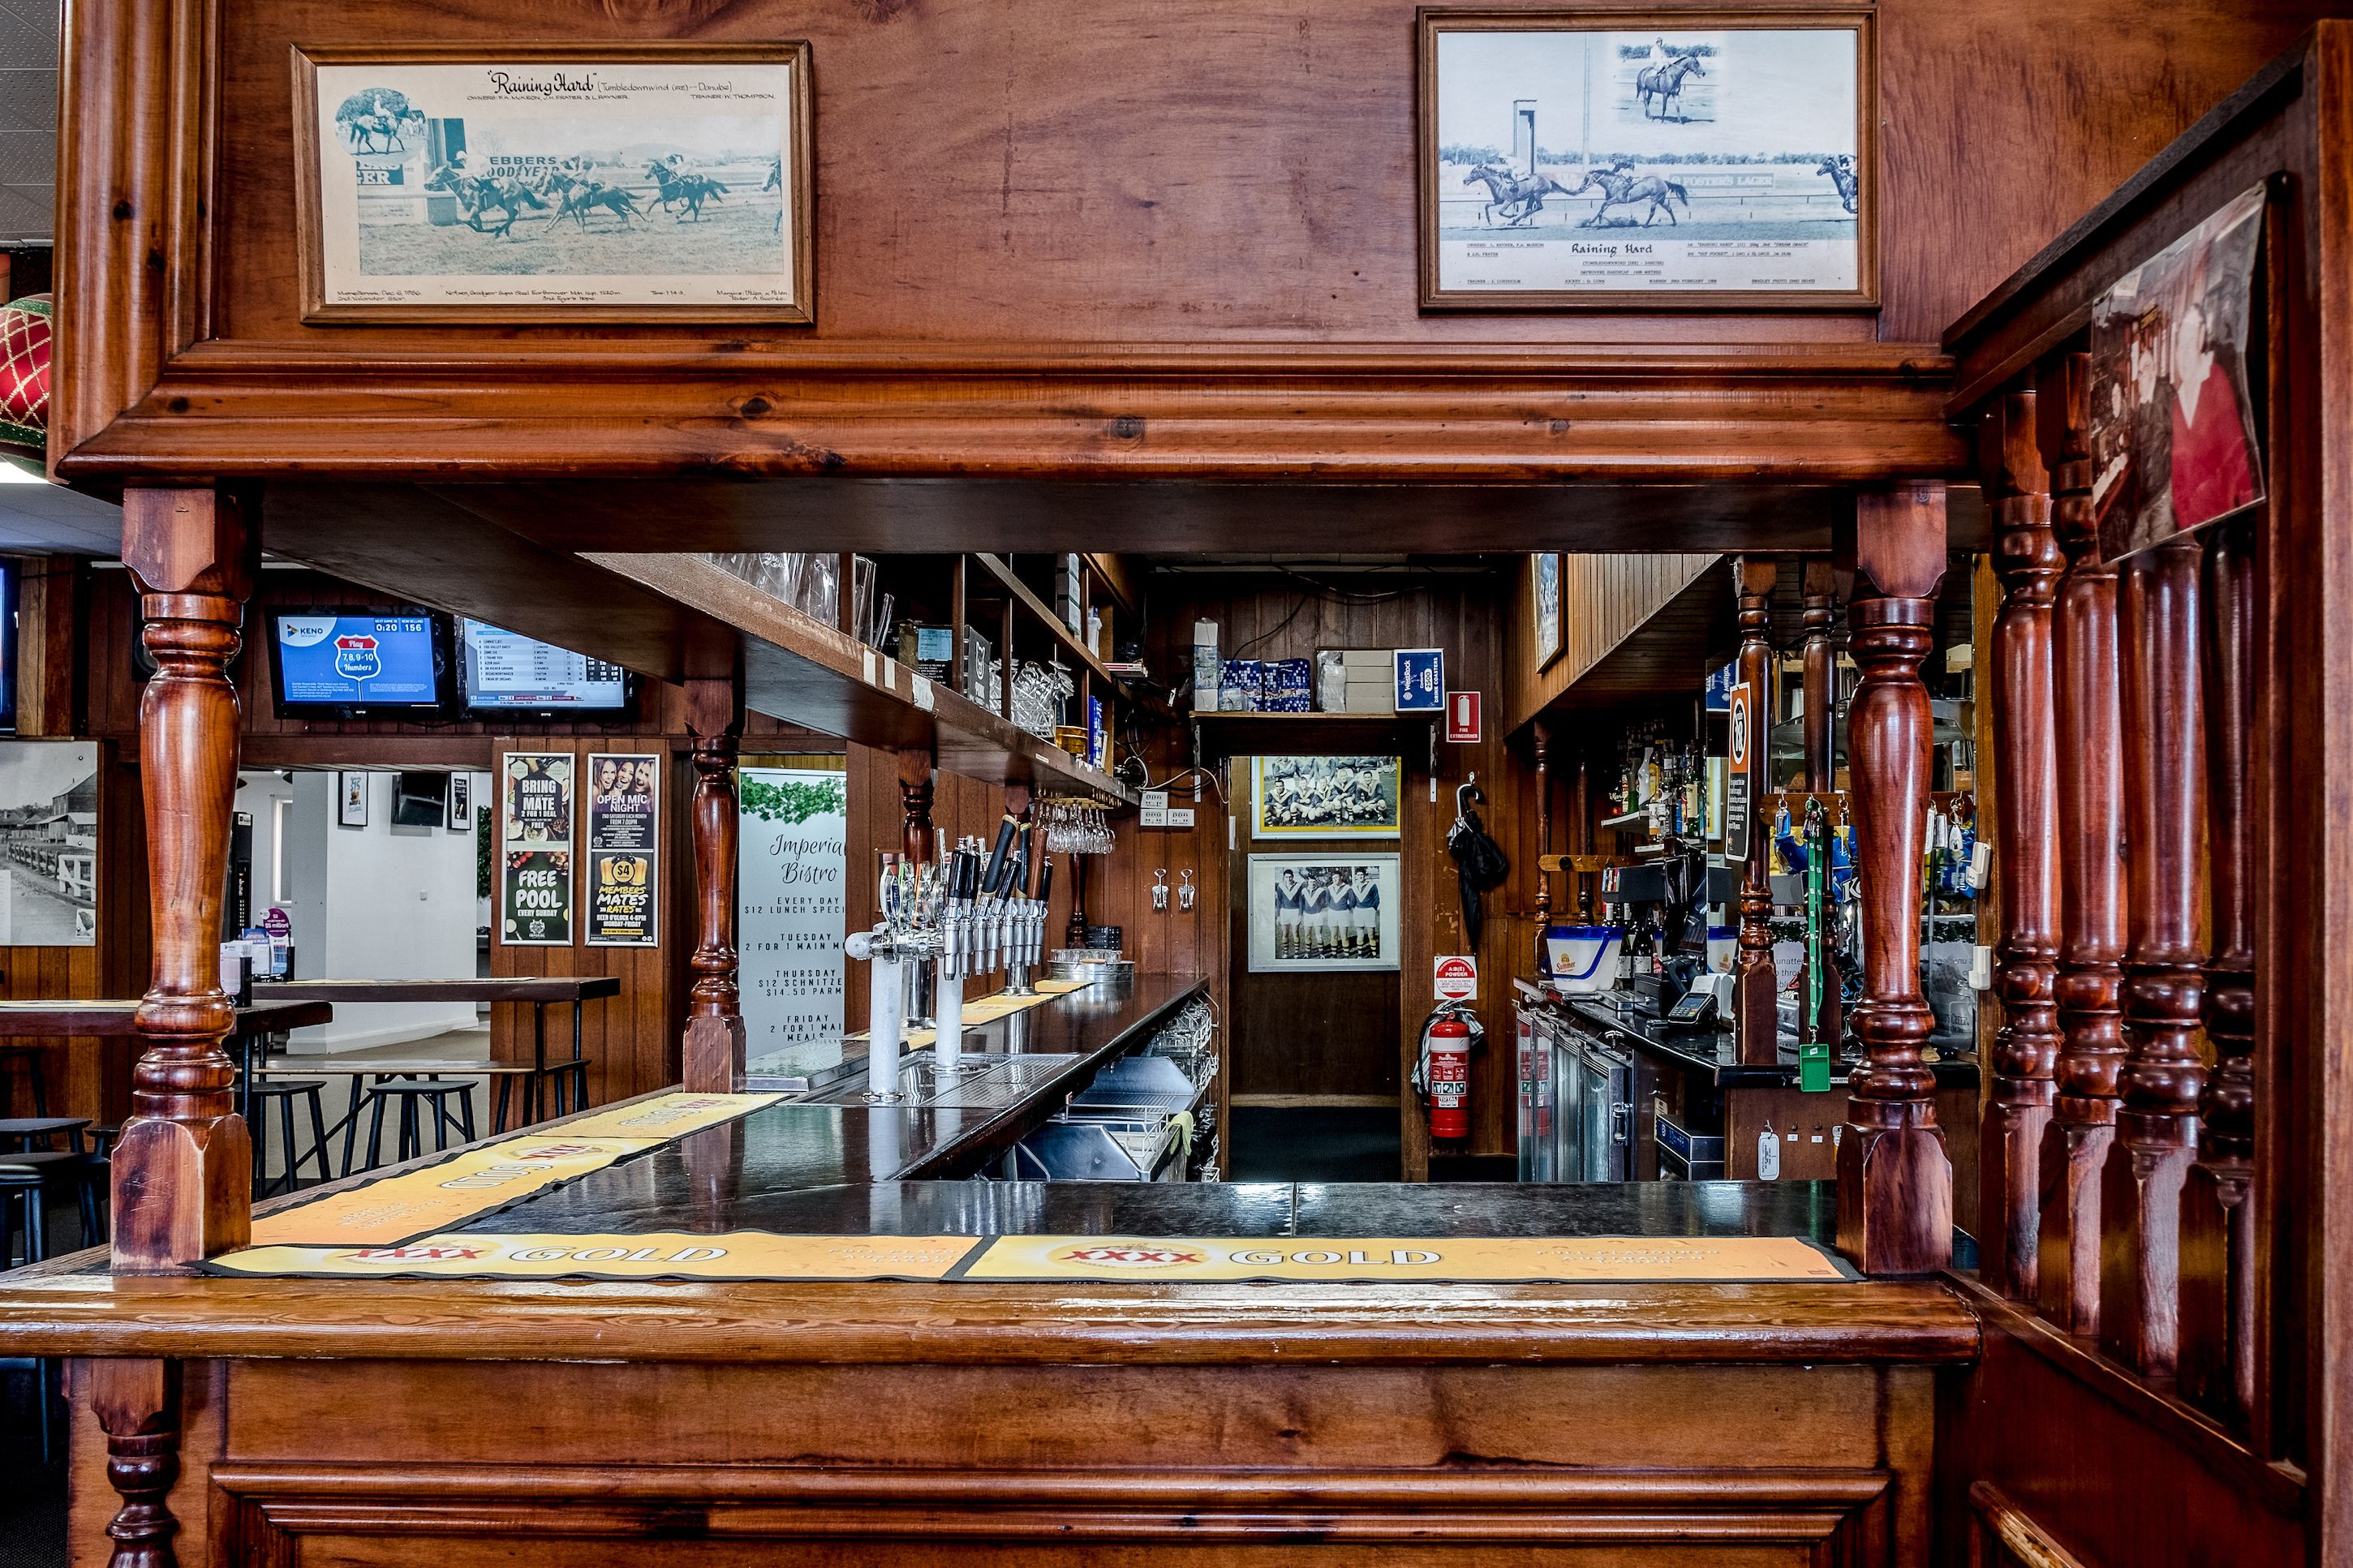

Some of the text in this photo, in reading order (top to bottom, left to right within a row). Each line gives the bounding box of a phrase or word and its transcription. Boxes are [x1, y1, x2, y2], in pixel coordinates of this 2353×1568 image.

[1571, 243, 1652, 258] Raining Hard
[300, 627, 324, 635] KENO
[405, 624, 422, 632] 156
[348, 640, 364, 649] Play
[343, 664, 372, 672] Numbers
[522, 780, 557, 794] BRING
[523, 797, 555, 810] MATE
[596, 795, 647, 804] OPEN MIC
[610, 804, 641, 813] NIGHT
[617, 865, 630, 875] $4
[781, 861, 838, 885] Bistro
[518, 870, 557, 887] FREE
[598, 886, 647, 895] MEMBERS
[515, 889, 563, 909] POOL
[596, 894, 649, 906] MATES
[777, 896, 839, 904] EVERY DAY
[517, 909, 557, 917] EVERY SUNDAY
[606, 905, 636, 913] RATES
[744, 906, 763, 914] $12
[770, 906, 806, 914] LUNCH
[781, 933, 832, 941] TUESDAY
[746, 943, 826, 951] 2 FOR 1 MAIN
[776, 969, 836, 977] THURSDAY
[759, 977, 842, 988] $12 SCHNITZE
[766, 988, 806, 996] $14.50
[787, 1015, 829, 1023] FRIDAY
[783, 1025, 803, 1033] FOR
[439, 1164, 554, 1189] GOLD
[336, 1245, 729, 1263] XXXX GOLD
[1059, 1248, 1442, 1265] XXXX GOLD
